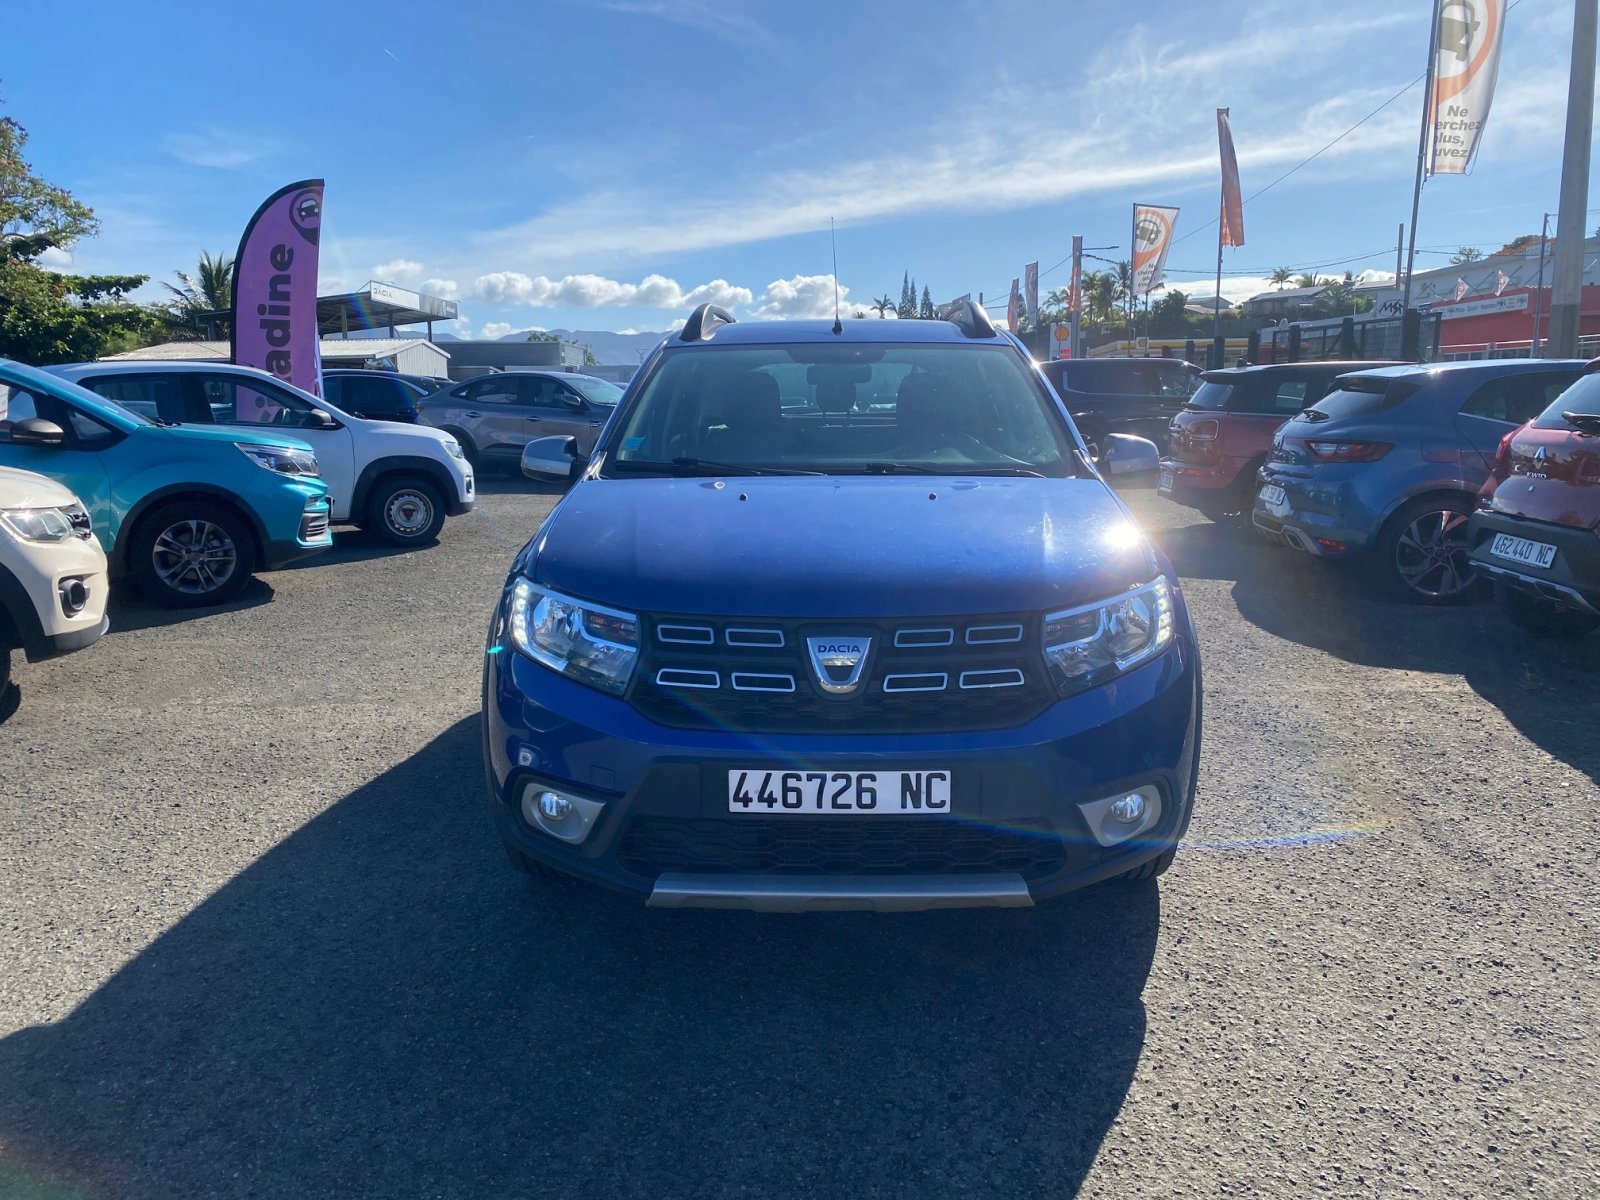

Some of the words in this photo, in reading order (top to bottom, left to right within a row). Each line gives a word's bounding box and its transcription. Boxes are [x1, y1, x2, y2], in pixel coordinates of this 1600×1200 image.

[1447, 105, 1468, 117] Ne
[1436, 120, 1481, 131] erchez
[1437, 132, 1464, 146] lus,
[1435, 148, 1468, 158] uvez
[1535, 544, 1553, 565] NC
[818, 645, 861, 653] DACIA
[732, 772, 877, 809] 446726
[900, 772, 947, 809] NC
